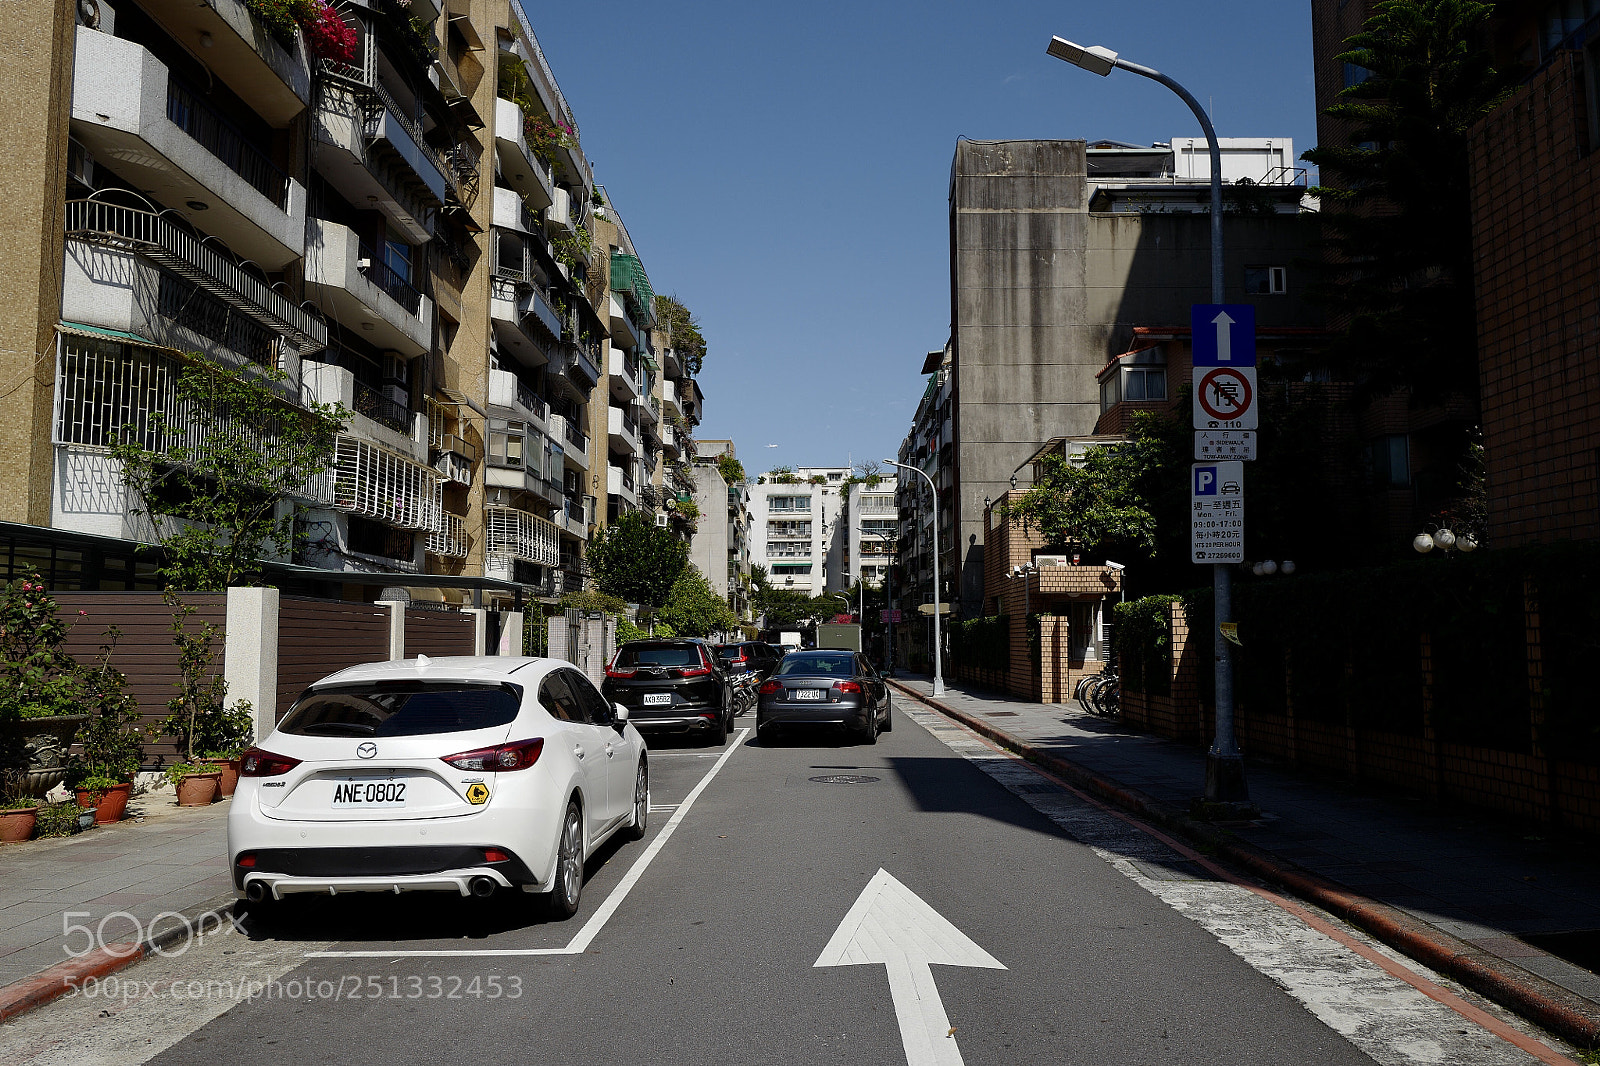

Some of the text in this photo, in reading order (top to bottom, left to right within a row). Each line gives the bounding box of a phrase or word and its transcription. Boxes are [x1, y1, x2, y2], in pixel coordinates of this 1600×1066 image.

[1213, 381, 1239, 407] 停
[1198, 471, 1213, 492] P
[1193, 500, 1241, 511] 週一至週五
[1193, 520, 1242, 529] 09:00-17:00
[1195, 530, 1241, 540] 每小時20元
